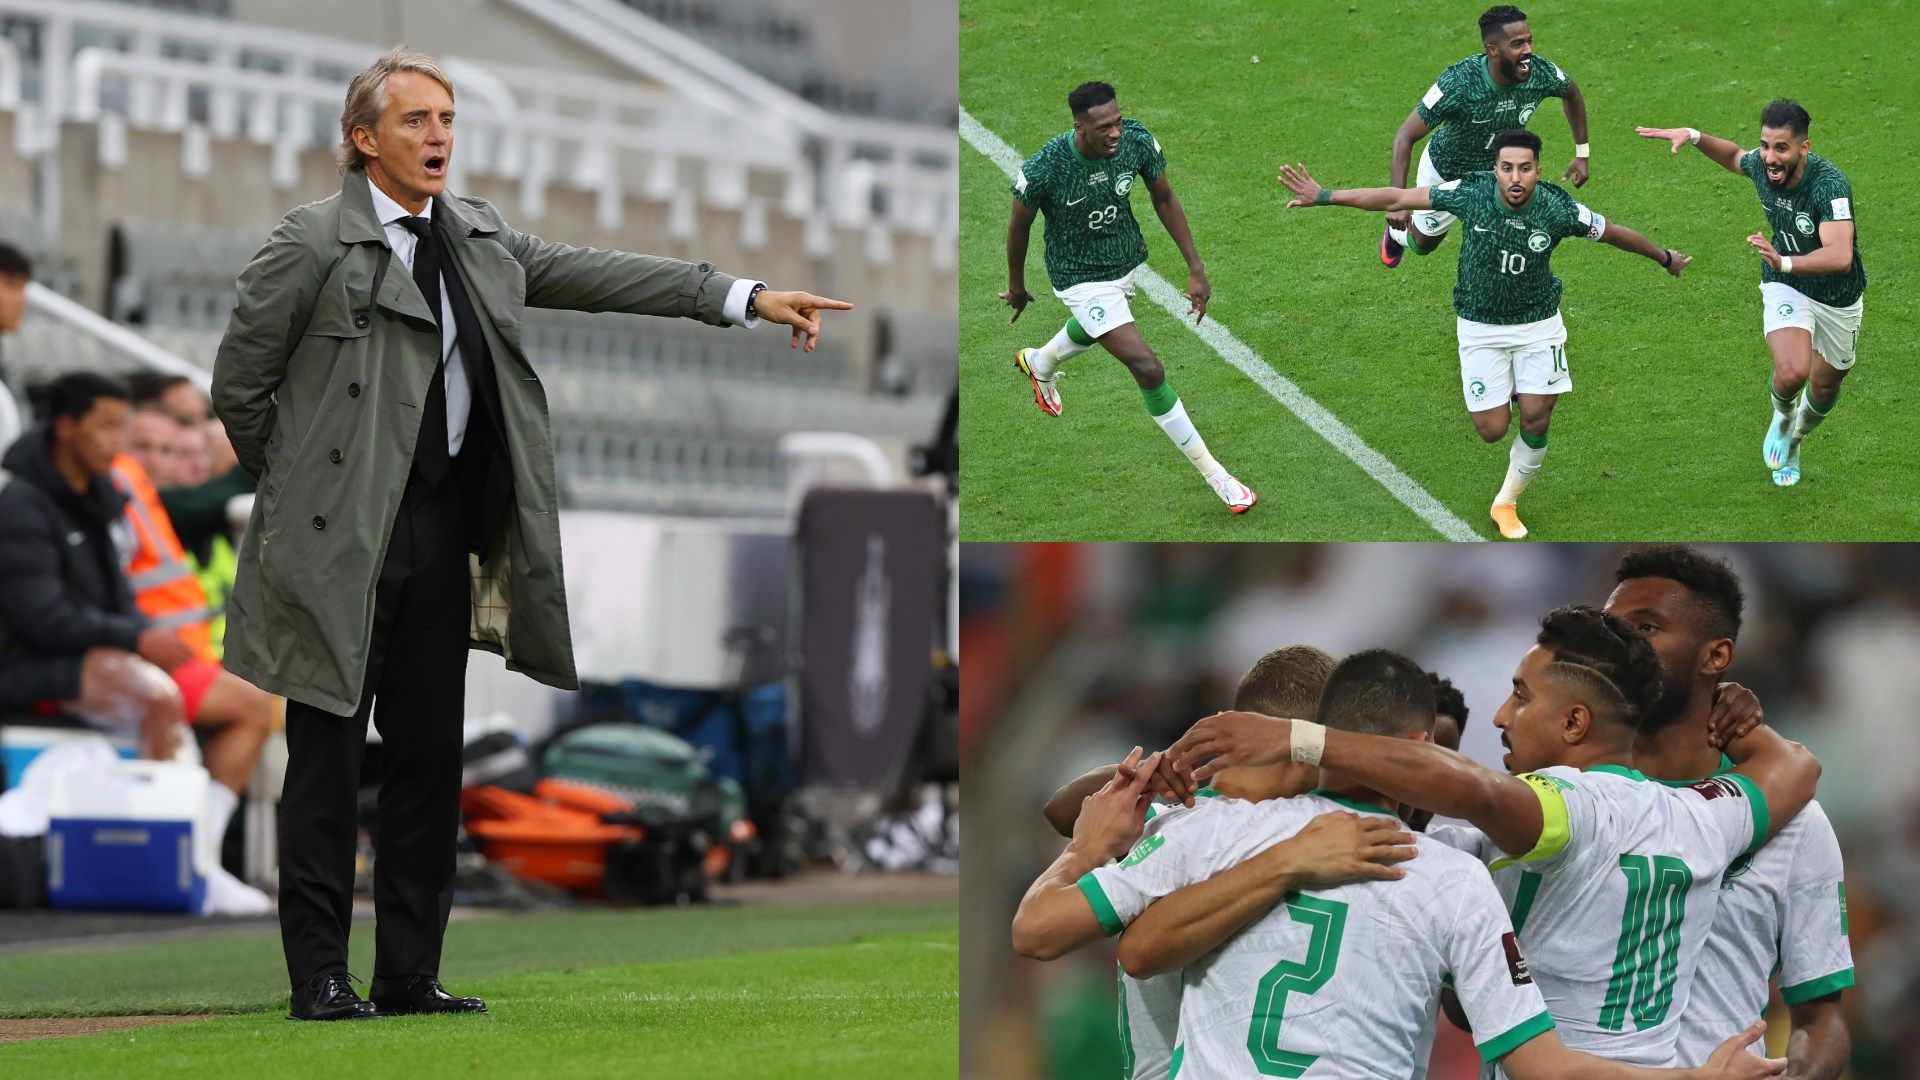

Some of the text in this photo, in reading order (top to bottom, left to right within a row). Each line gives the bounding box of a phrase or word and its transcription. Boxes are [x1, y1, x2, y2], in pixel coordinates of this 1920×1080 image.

[1088, 204, 1118, 230] 23
[1780, 229, 1801, 253] 11
[1500, 249, 1526, 275] 10
[1596, 853, 1694, 1033] 10
[1246, 890, 1349, 1079] 2
